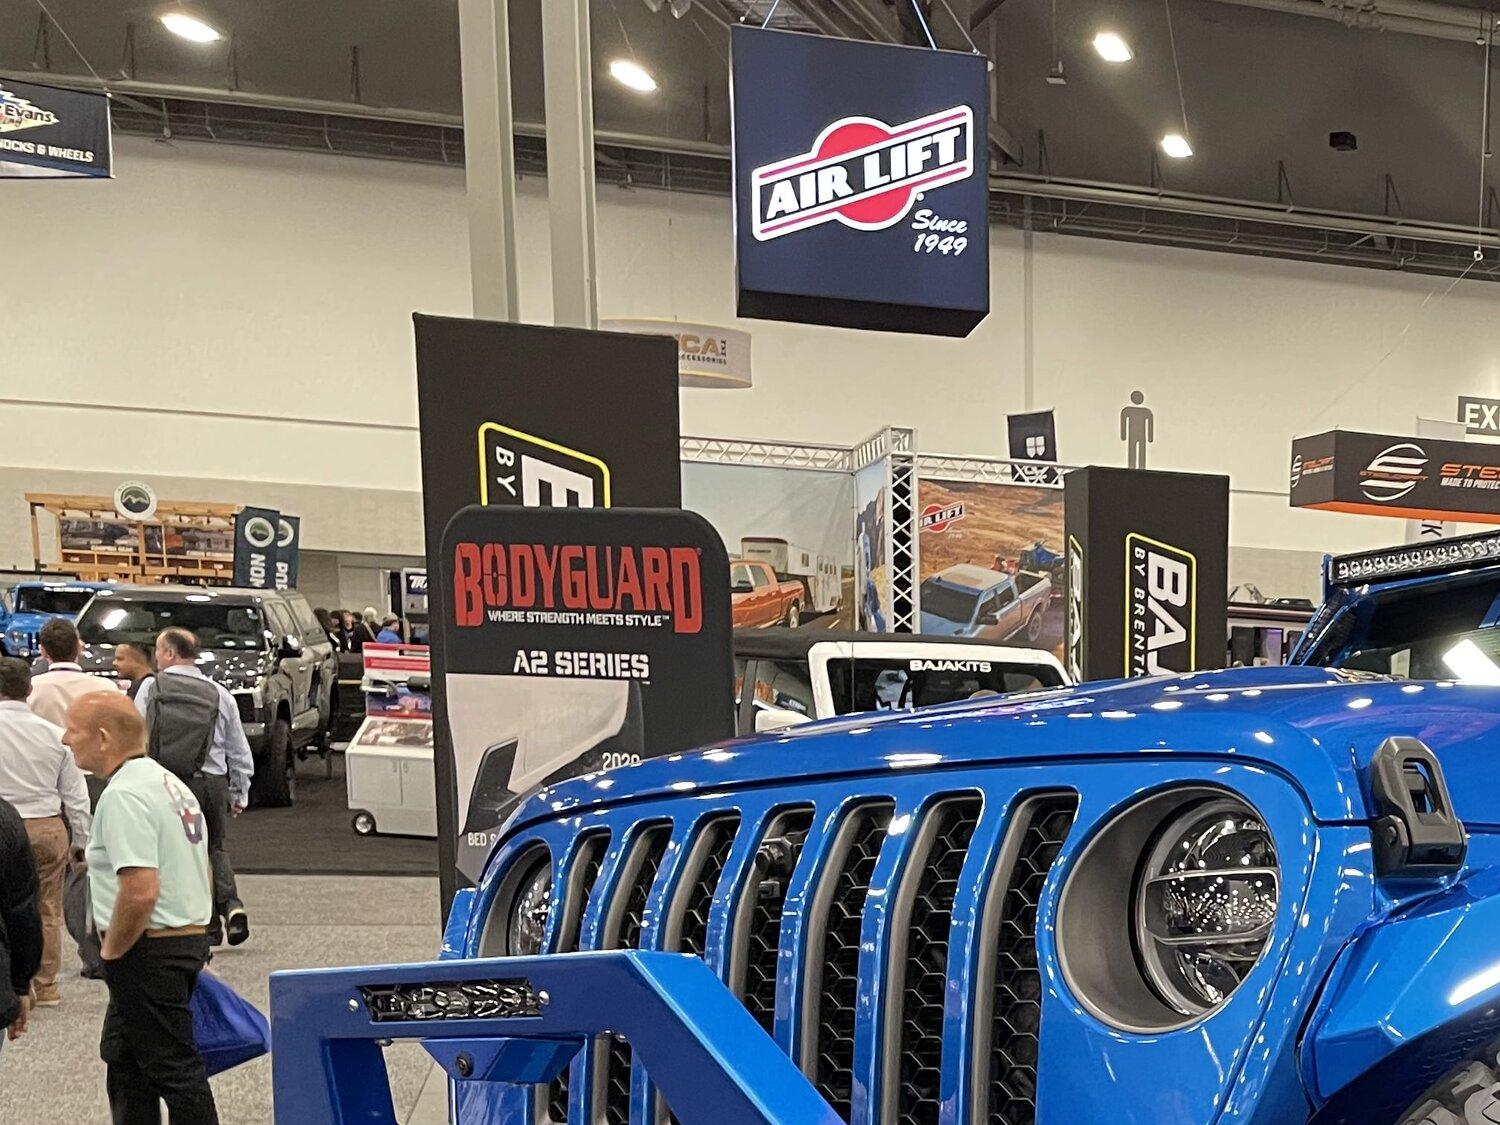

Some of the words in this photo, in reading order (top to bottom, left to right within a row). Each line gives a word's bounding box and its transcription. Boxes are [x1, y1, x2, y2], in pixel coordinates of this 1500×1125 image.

[4, 104, 53, 123] Evans
[48, 145, 95, 163] WHEELS
[765, 165, 854, 220] AIR
[862, 126, 961, 191] LIFT
[911, 208, 968, 234] Since
[913, 232, 968, 257] 1949
[495, 446, 516, 497] BY
[1440, 476, 1462, 488] MADE
[1463, 478, 1474, 489] TO
[935, 504, 963, 525] LIFT
[1133, 546, 1146, 577] BY
[454, 542, 703, 634] BODYGUARD
[487, 609, 526, 623] WHERE
[526, 610, 585, 625] STRENGTH
[585, 612, 625, 626] MEETS
[513, 649, 549, 675] A2
[555, 651, 650, 679] SERIES
[909, 659, 993, 673] BAJAKITS
[467, 832, 487, 847] BED
